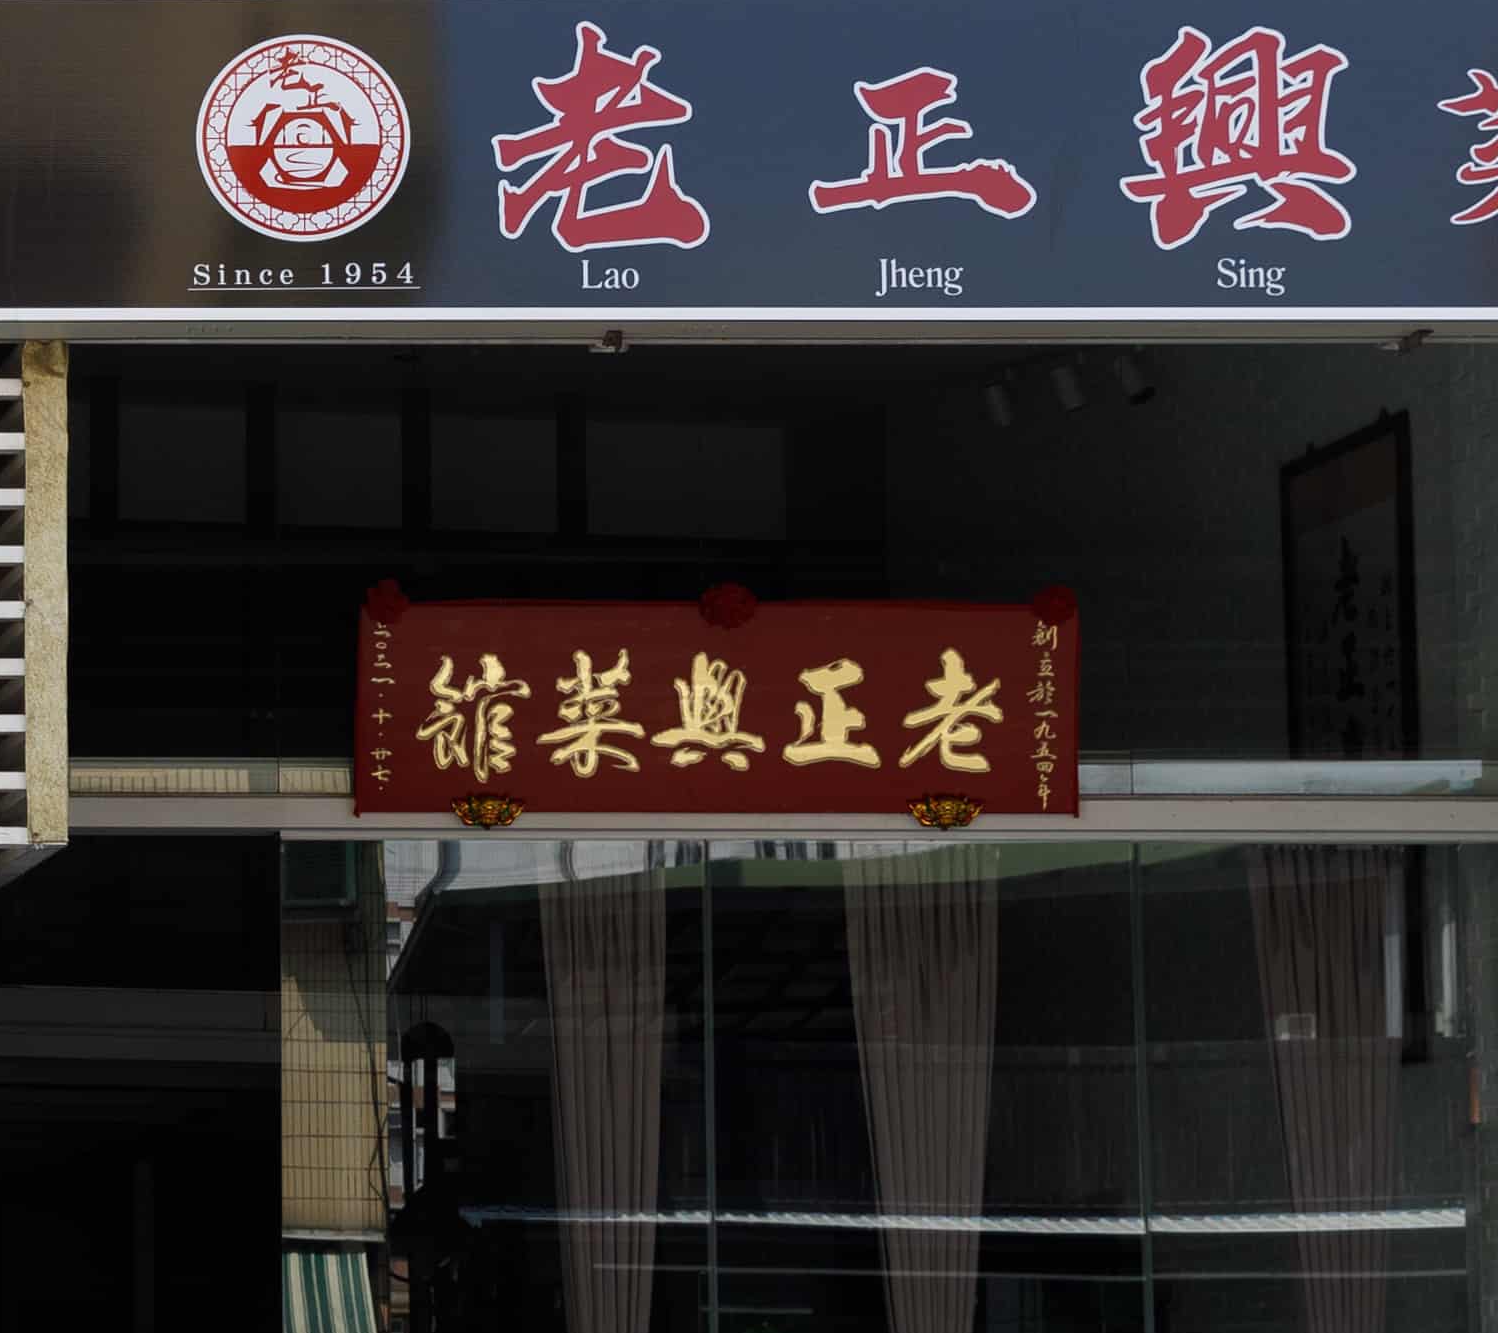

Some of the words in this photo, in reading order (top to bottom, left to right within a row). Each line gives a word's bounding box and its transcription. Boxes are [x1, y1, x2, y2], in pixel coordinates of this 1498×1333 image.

[192, 262, 297, 287] Since
[318, 262, 417, 287] 1954
[579, 259, 642, 292] Lao
[875, 258, 965, 297] Jheng
[1215, 256, 1287, 297] Sing
